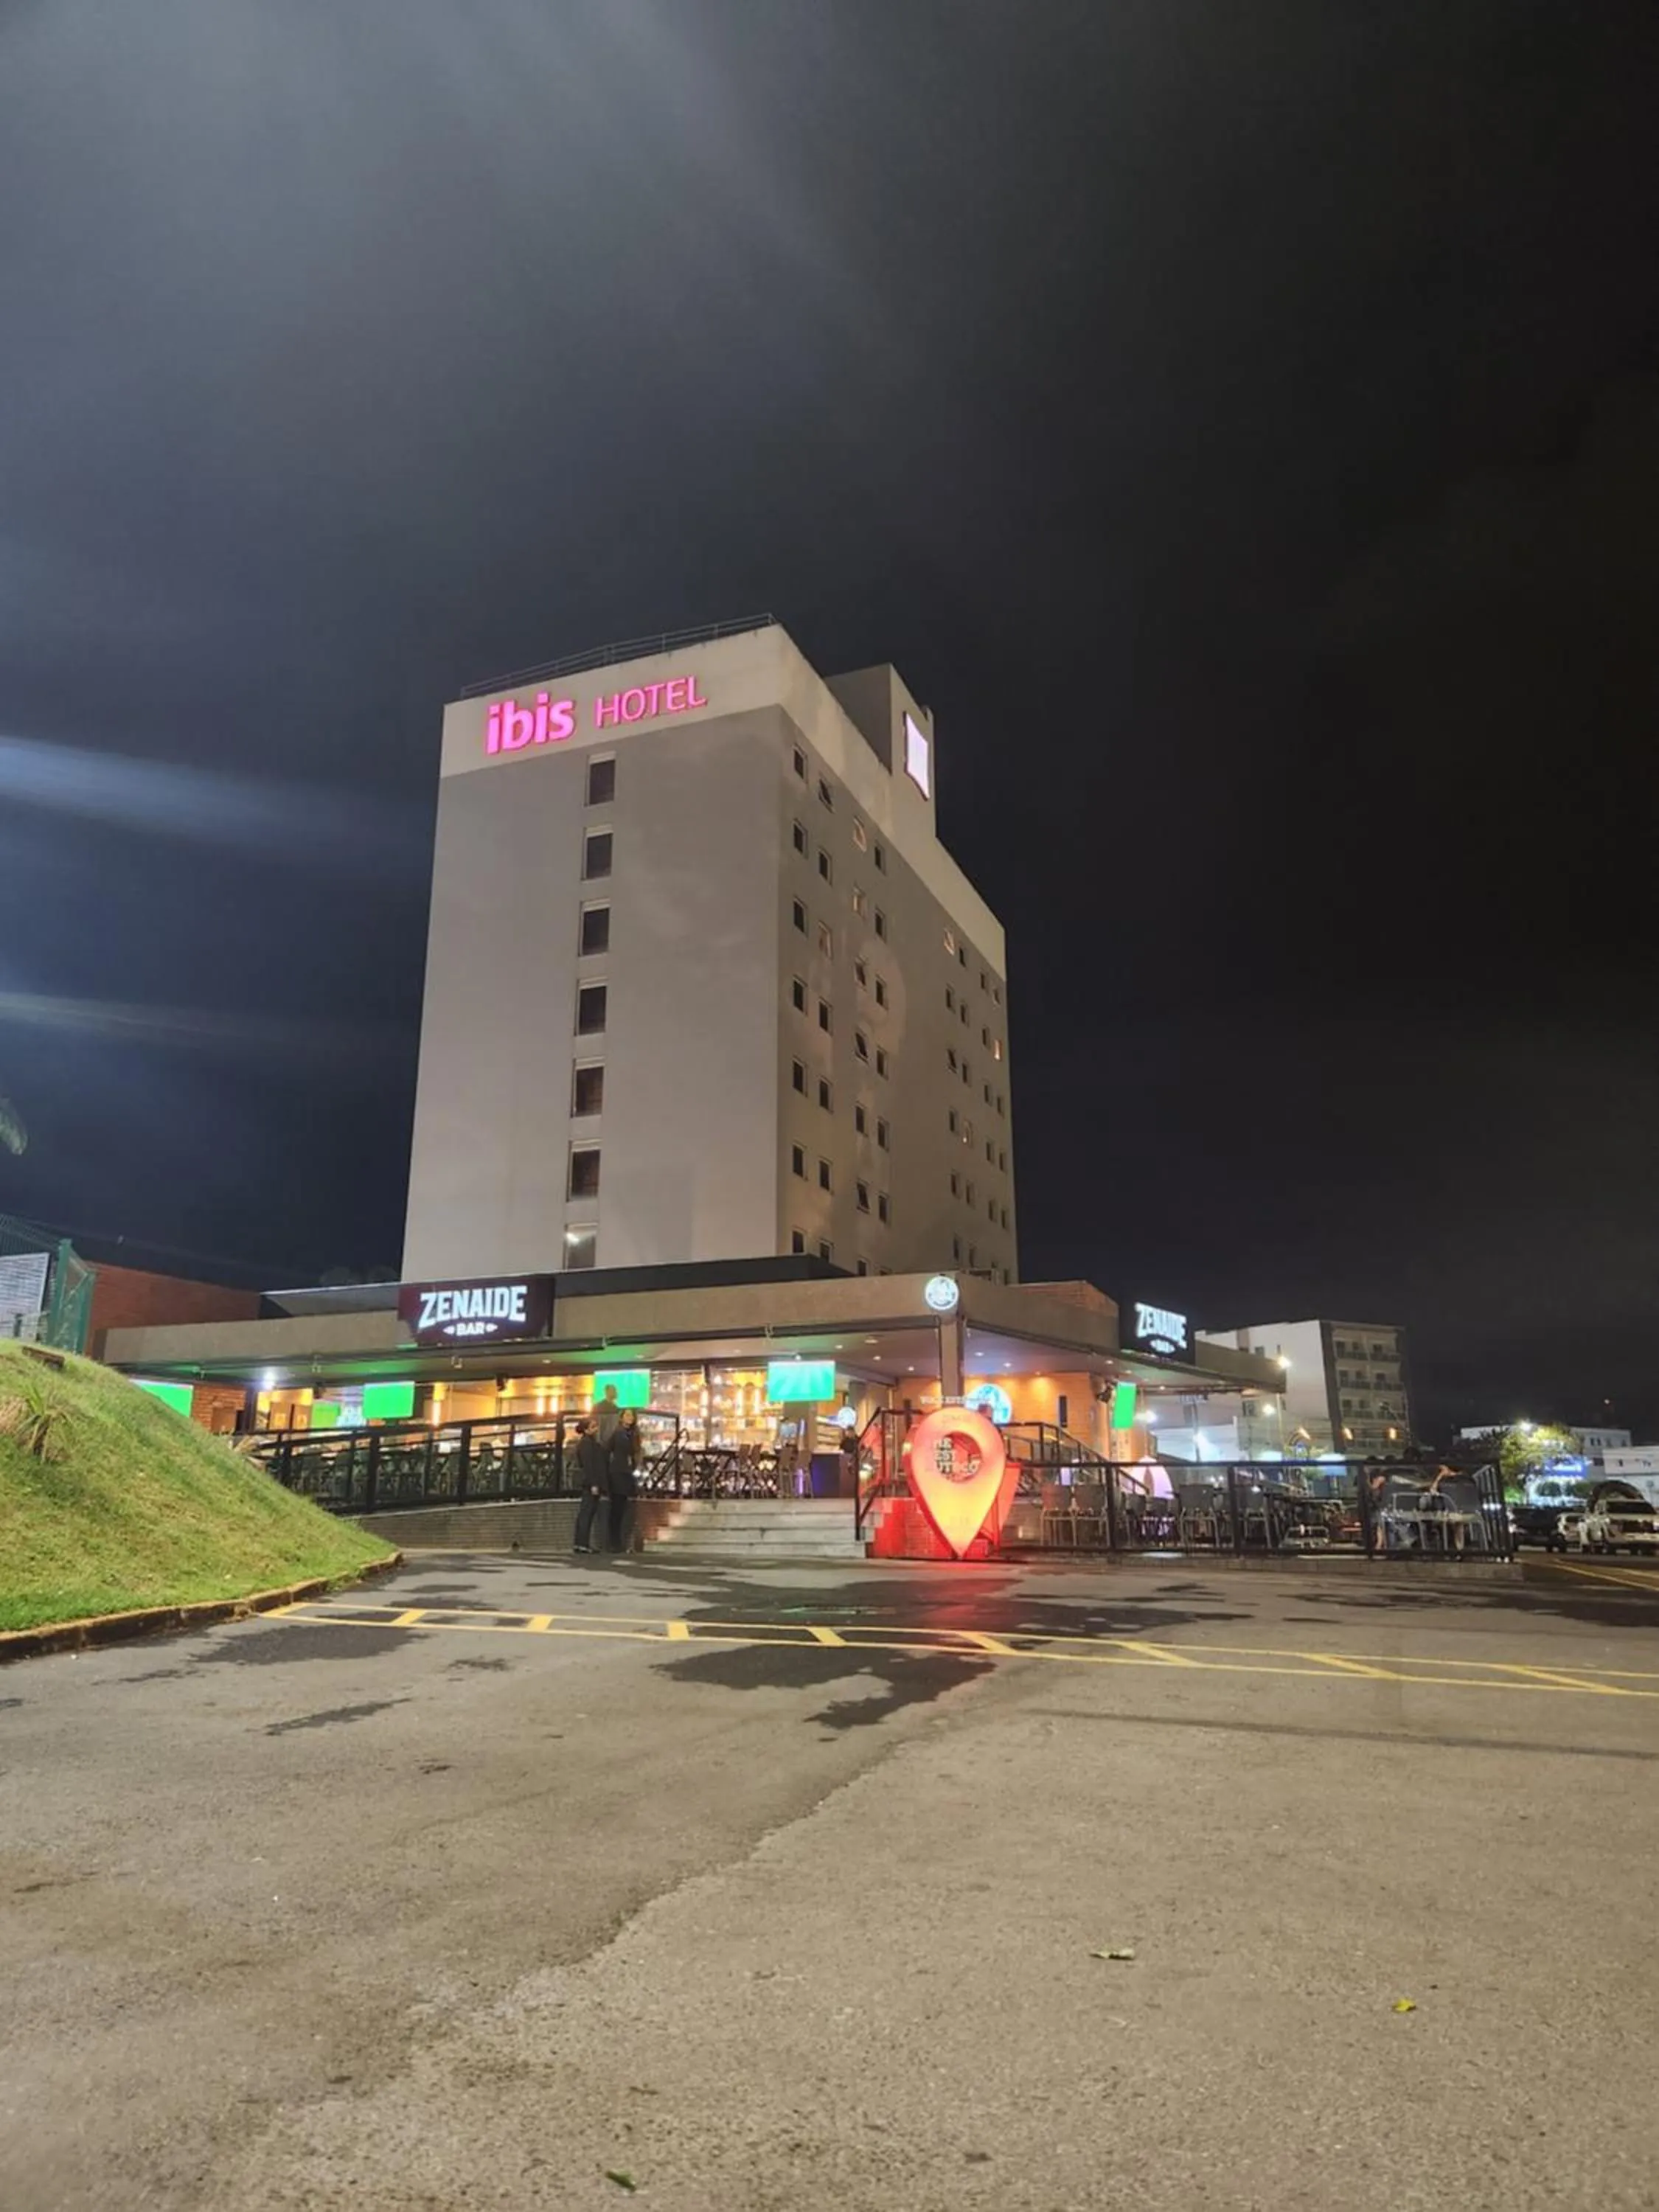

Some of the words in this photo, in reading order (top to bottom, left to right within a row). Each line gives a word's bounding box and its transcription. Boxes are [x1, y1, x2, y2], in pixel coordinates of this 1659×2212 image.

[485, 692, 576, 754] ibis
[595, 676, 707, 728] HOTEL
[418, 1285, 528, 1330] ZENAIDE
[456, 1322, 485, 1336] BAR
